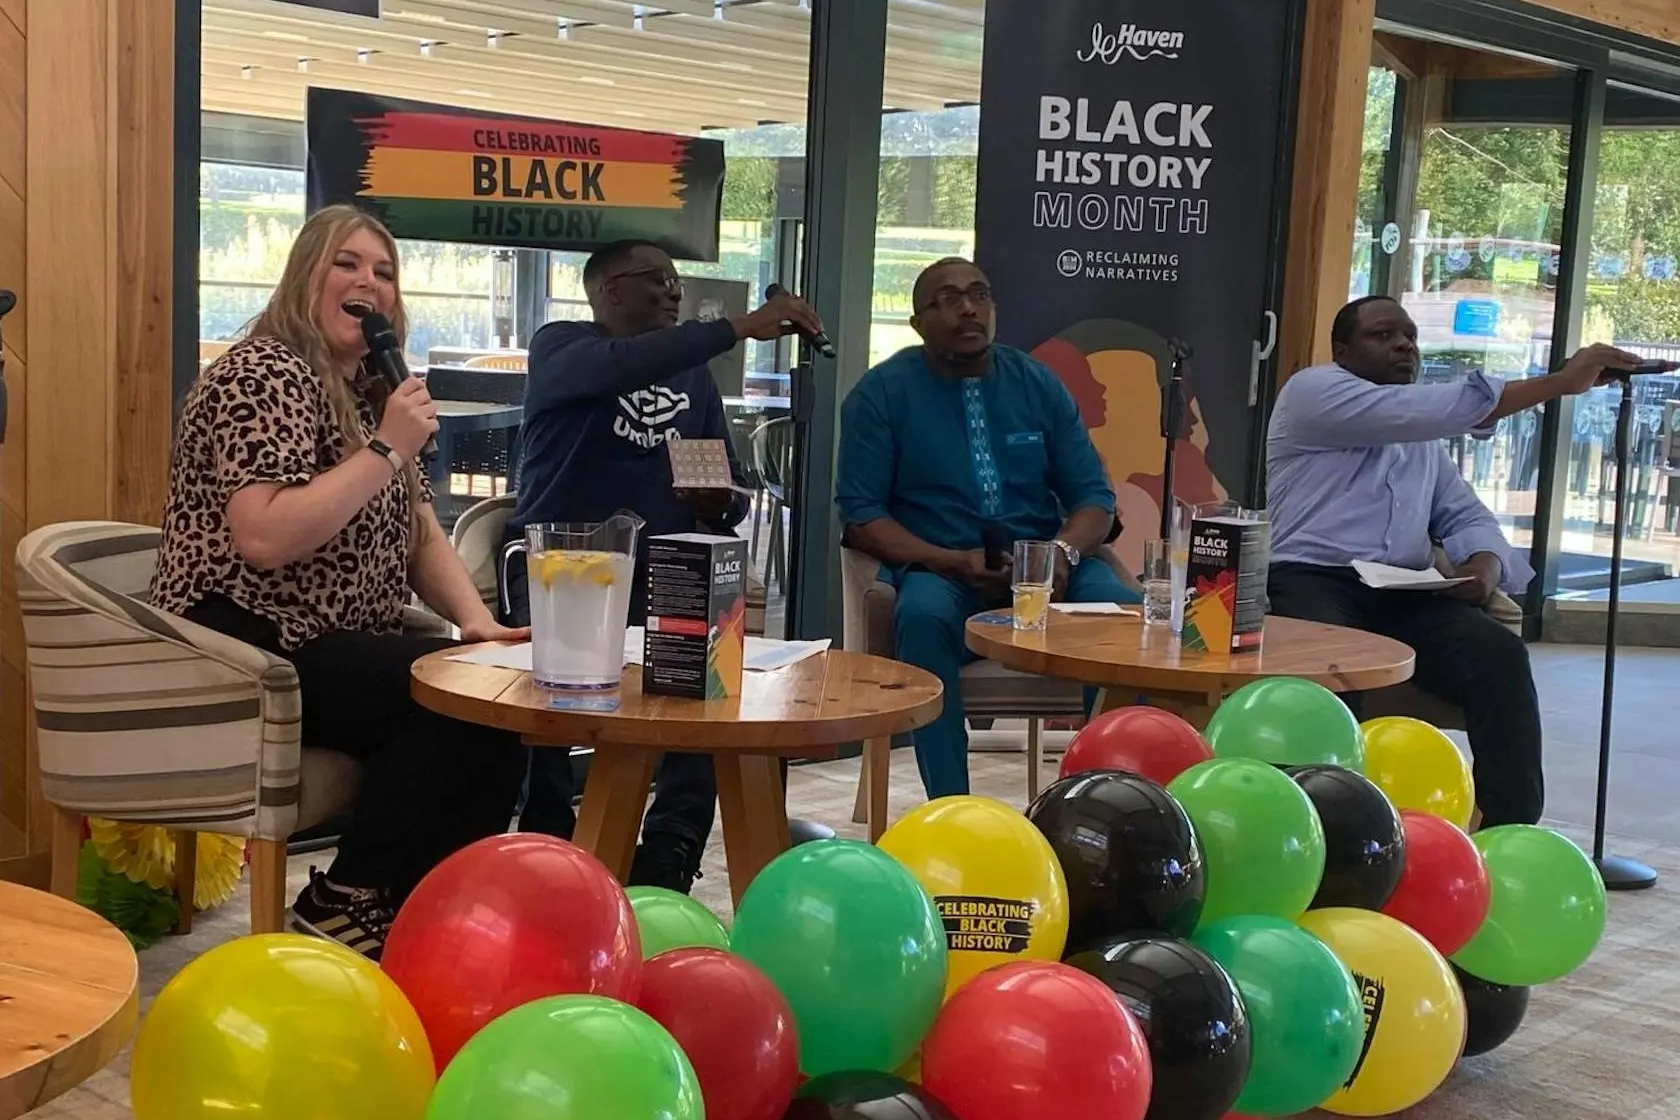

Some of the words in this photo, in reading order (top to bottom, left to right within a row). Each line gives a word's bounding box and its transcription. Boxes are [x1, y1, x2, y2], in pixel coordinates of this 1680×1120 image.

[1117, 24, 1184, 48] Haven
[1039, 95, 1214, 148] BLACK
[473, 129, 602, 156] CELEBRATING
[1036, 150, 1212, 189] HISTORY
[473, 155, 606, 201] BLACK
[1033, 191, 1208, 234] MONTH
[472, 205, 604, 239] HISTORY
[1085, 251, 1179, 266] RECLAIMING
[1085, 266, 1178, 281] NARRATIVES
[1193, 535, 1228, 549] BLACK
[1192, 547, 1228, 557] HISTORY
[714, 560, 741, 575] BLACK
[714, 573, 740, 585] HISTORY
[937, 902, 1029, 918] CELEBRATING
[960, 918, 1006, 933] BLACK
[951, 934, 1012, 950] HISTORY
